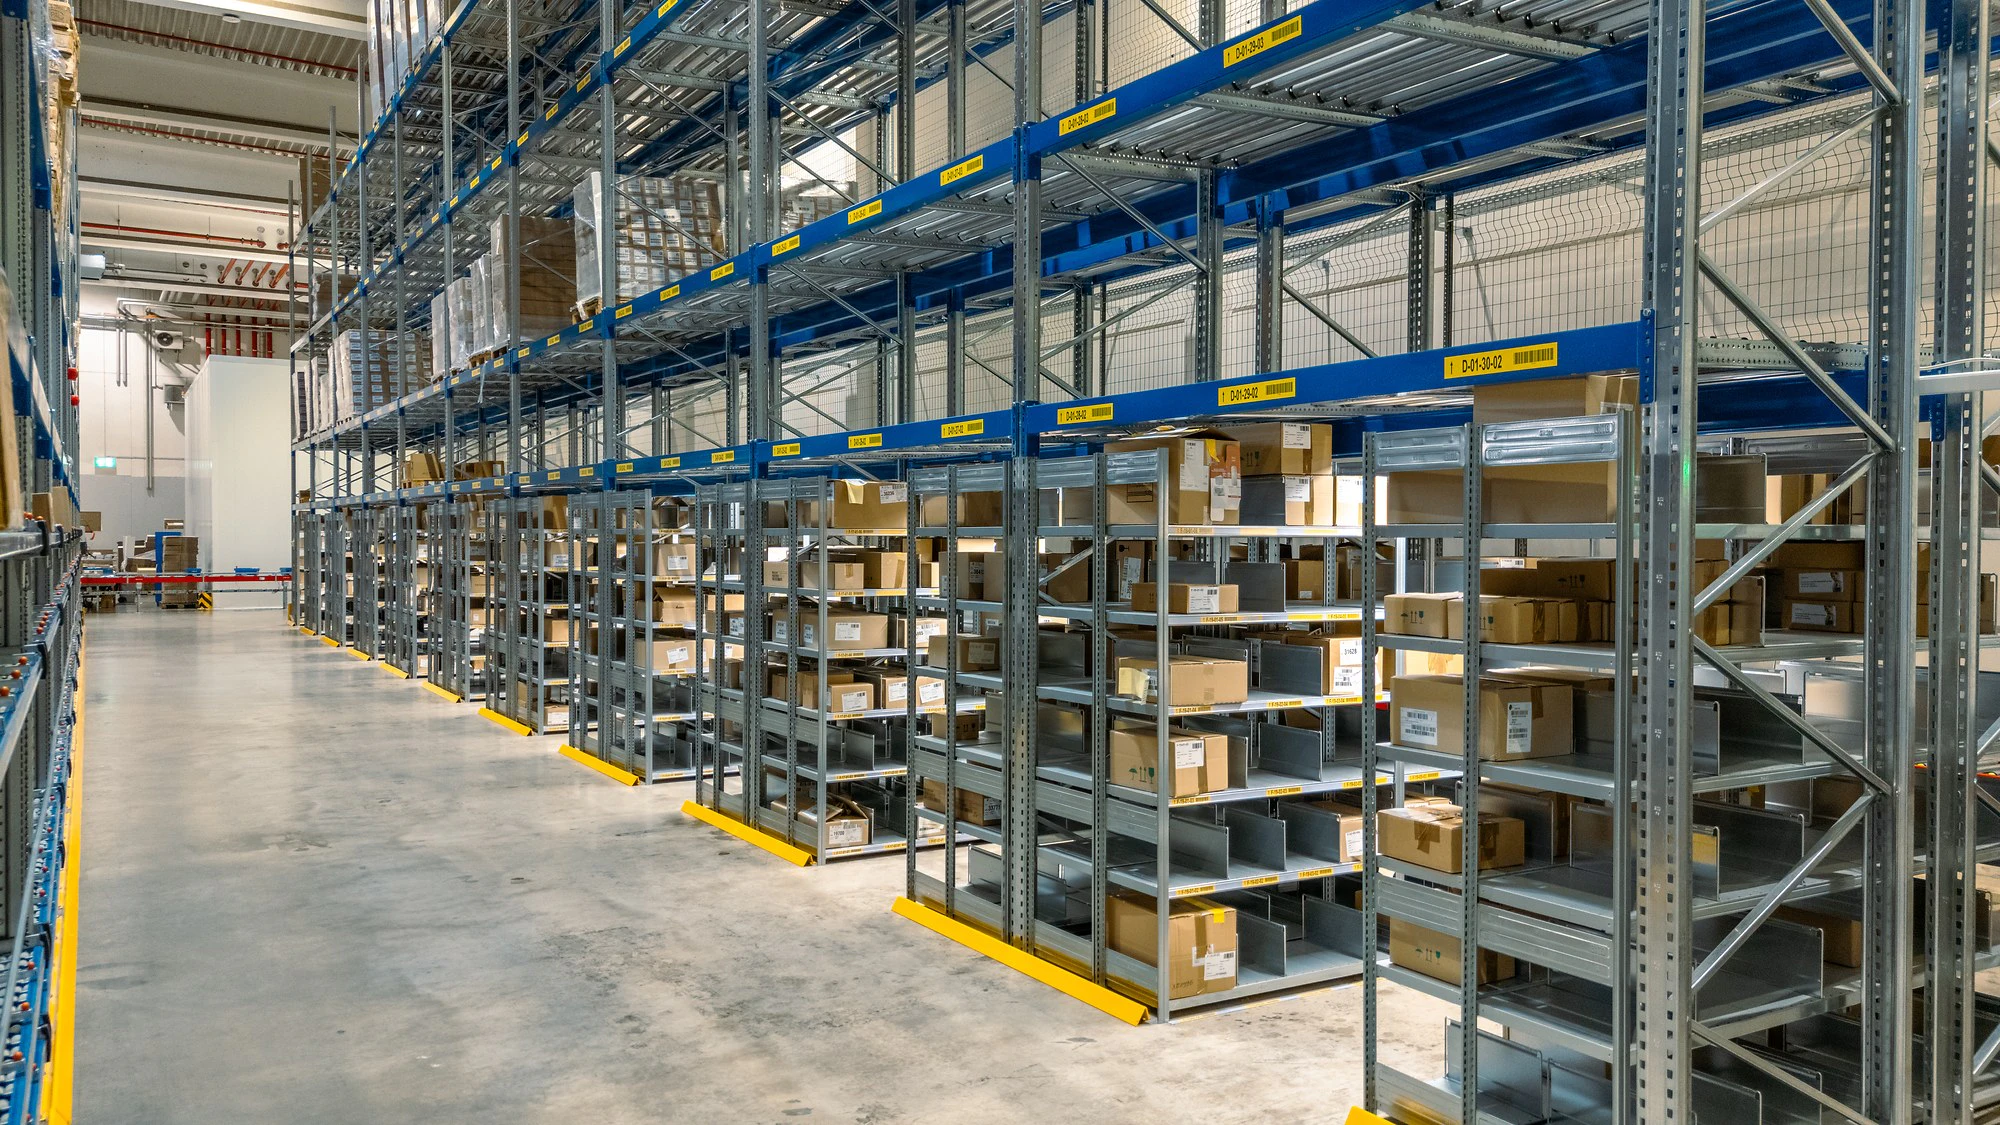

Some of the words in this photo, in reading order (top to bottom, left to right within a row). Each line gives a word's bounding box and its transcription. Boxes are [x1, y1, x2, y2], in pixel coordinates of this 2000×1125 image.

[1235, 36, 1265, 59] D-01-29-03
[1462, 354, 1503, 373] D-01-30-02
[1230, 386, 1259, 402] D-01-29-02
